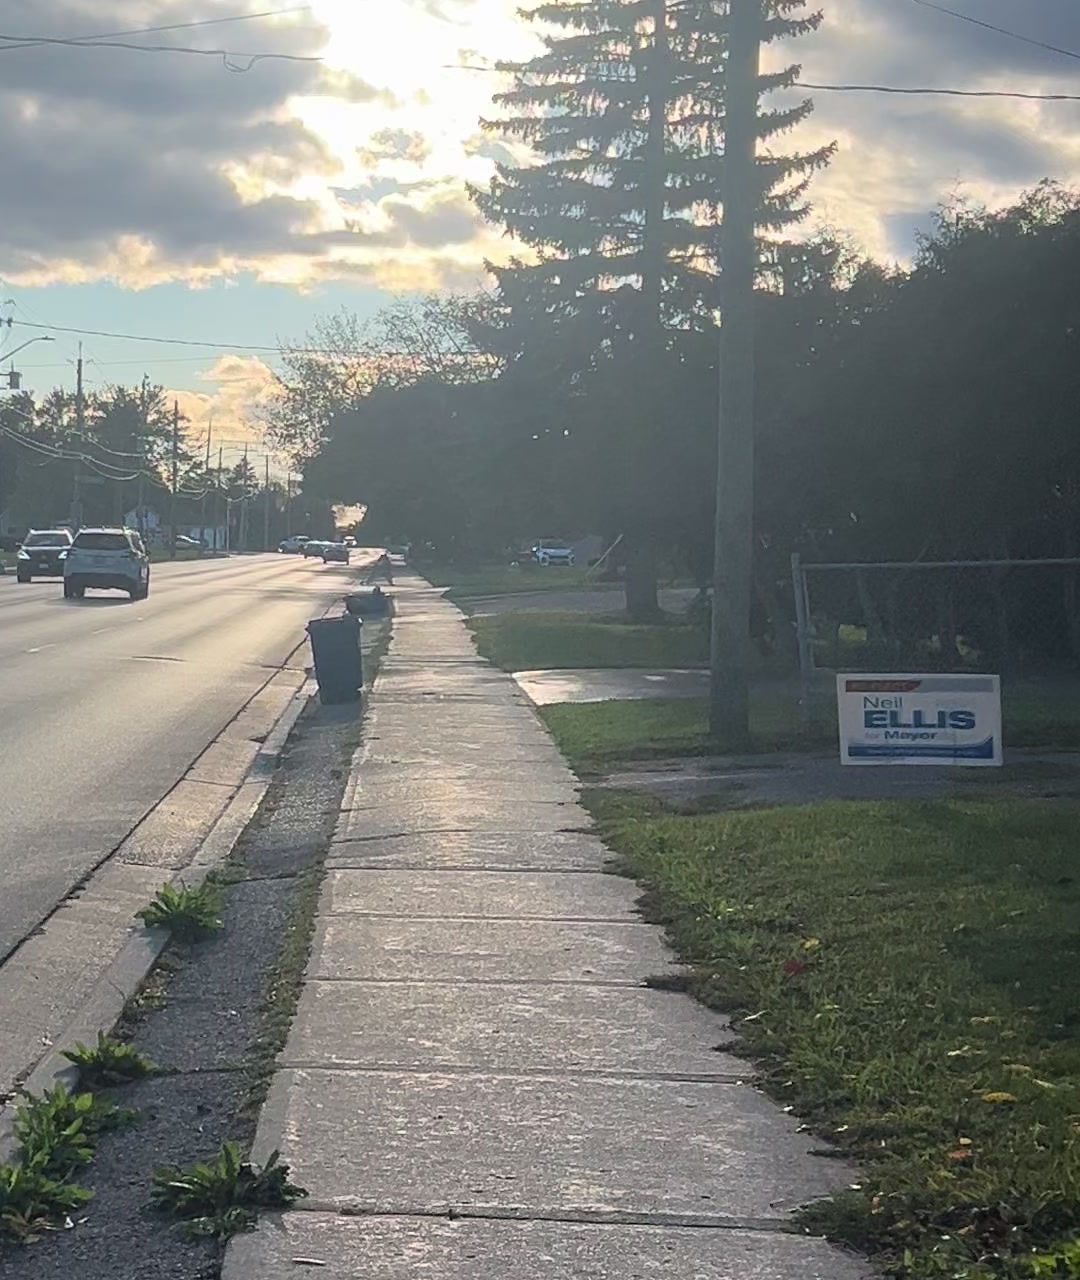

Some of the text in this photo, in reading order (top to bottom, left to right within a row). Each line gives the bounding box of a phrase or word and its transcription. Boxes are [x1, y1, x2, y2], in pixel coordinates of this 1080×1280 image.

[863, 696, 903, 709] Neil
[864, 710, 976, 730] ELLIS
[884, 730, 938, 741] Mayor
